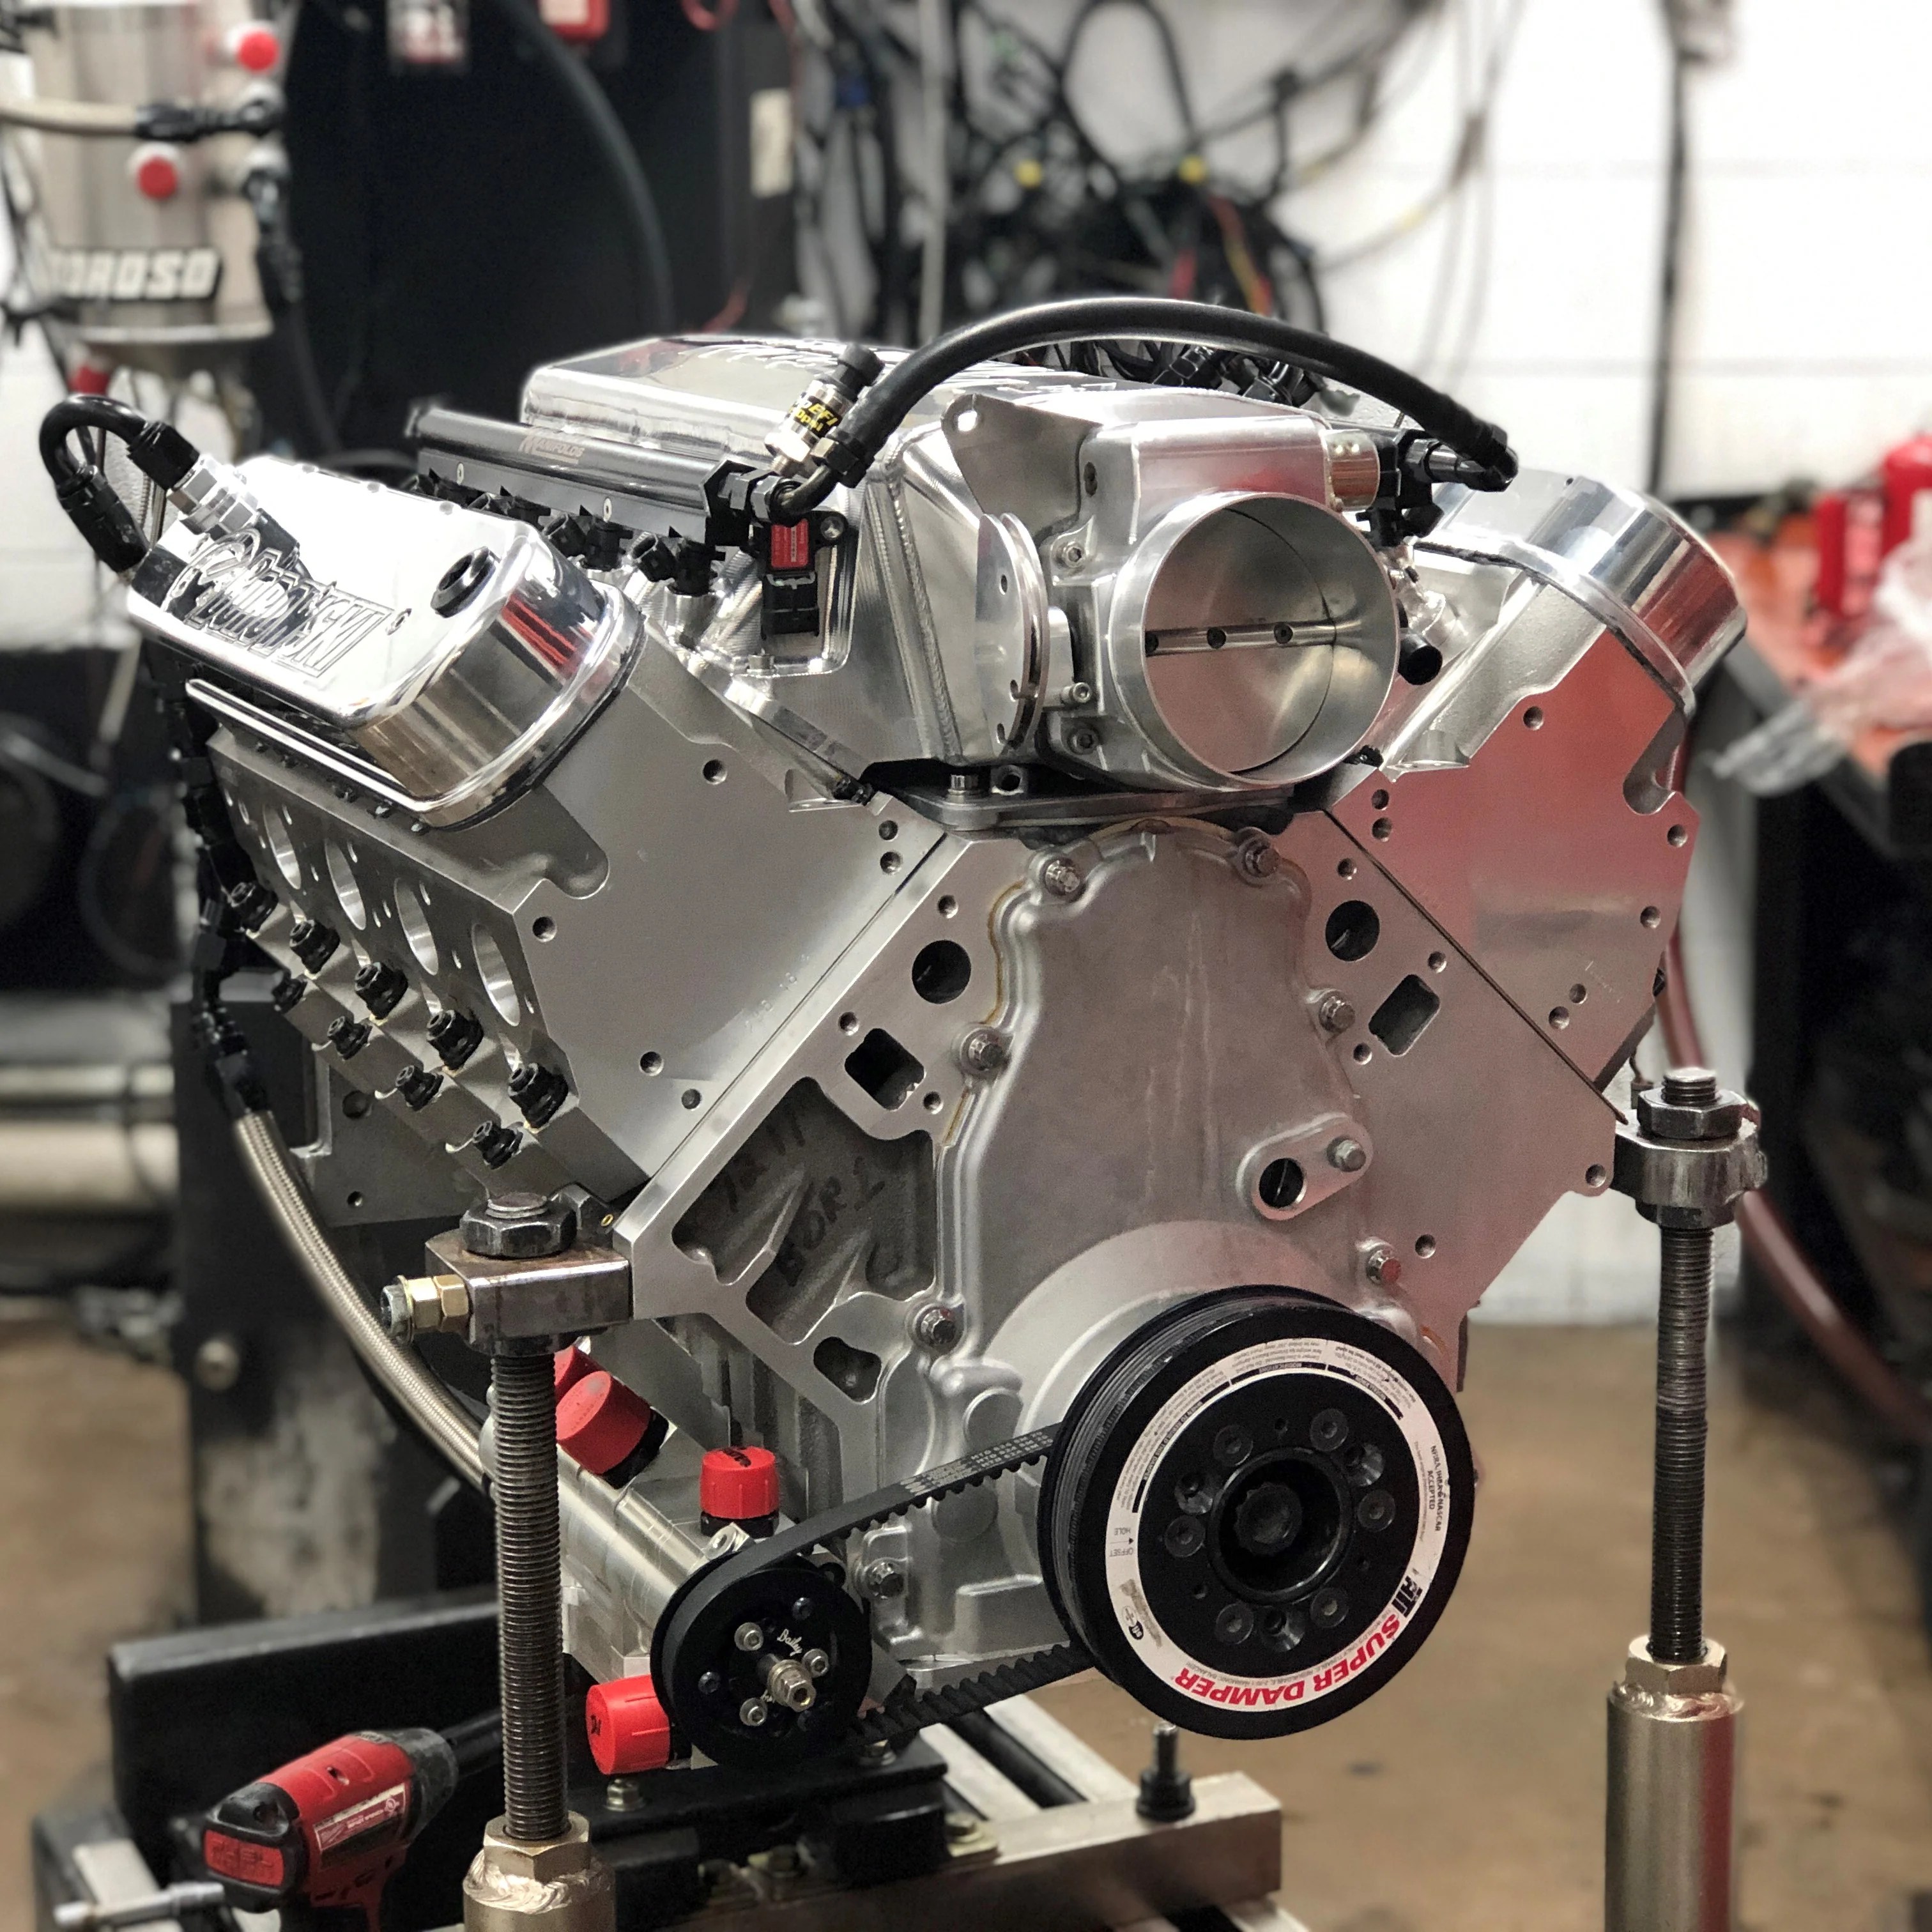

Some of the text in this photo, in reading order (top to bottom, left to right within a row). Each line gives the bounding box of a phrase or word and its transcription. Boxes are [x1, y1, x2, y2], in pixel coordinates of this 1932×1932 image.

[1427, 1469, 1435, 1510] ACCEPTED
[1113, 1527, 1131, 1535] HOLE
[1434, 1498, 1443, 1531] NASCAR
[1109, 1546, 1133, 1558] OFFSET
[1314, 1615, 1399, 1691] SUPER
[1176, 1669, 1304, 1705] DAMPER
